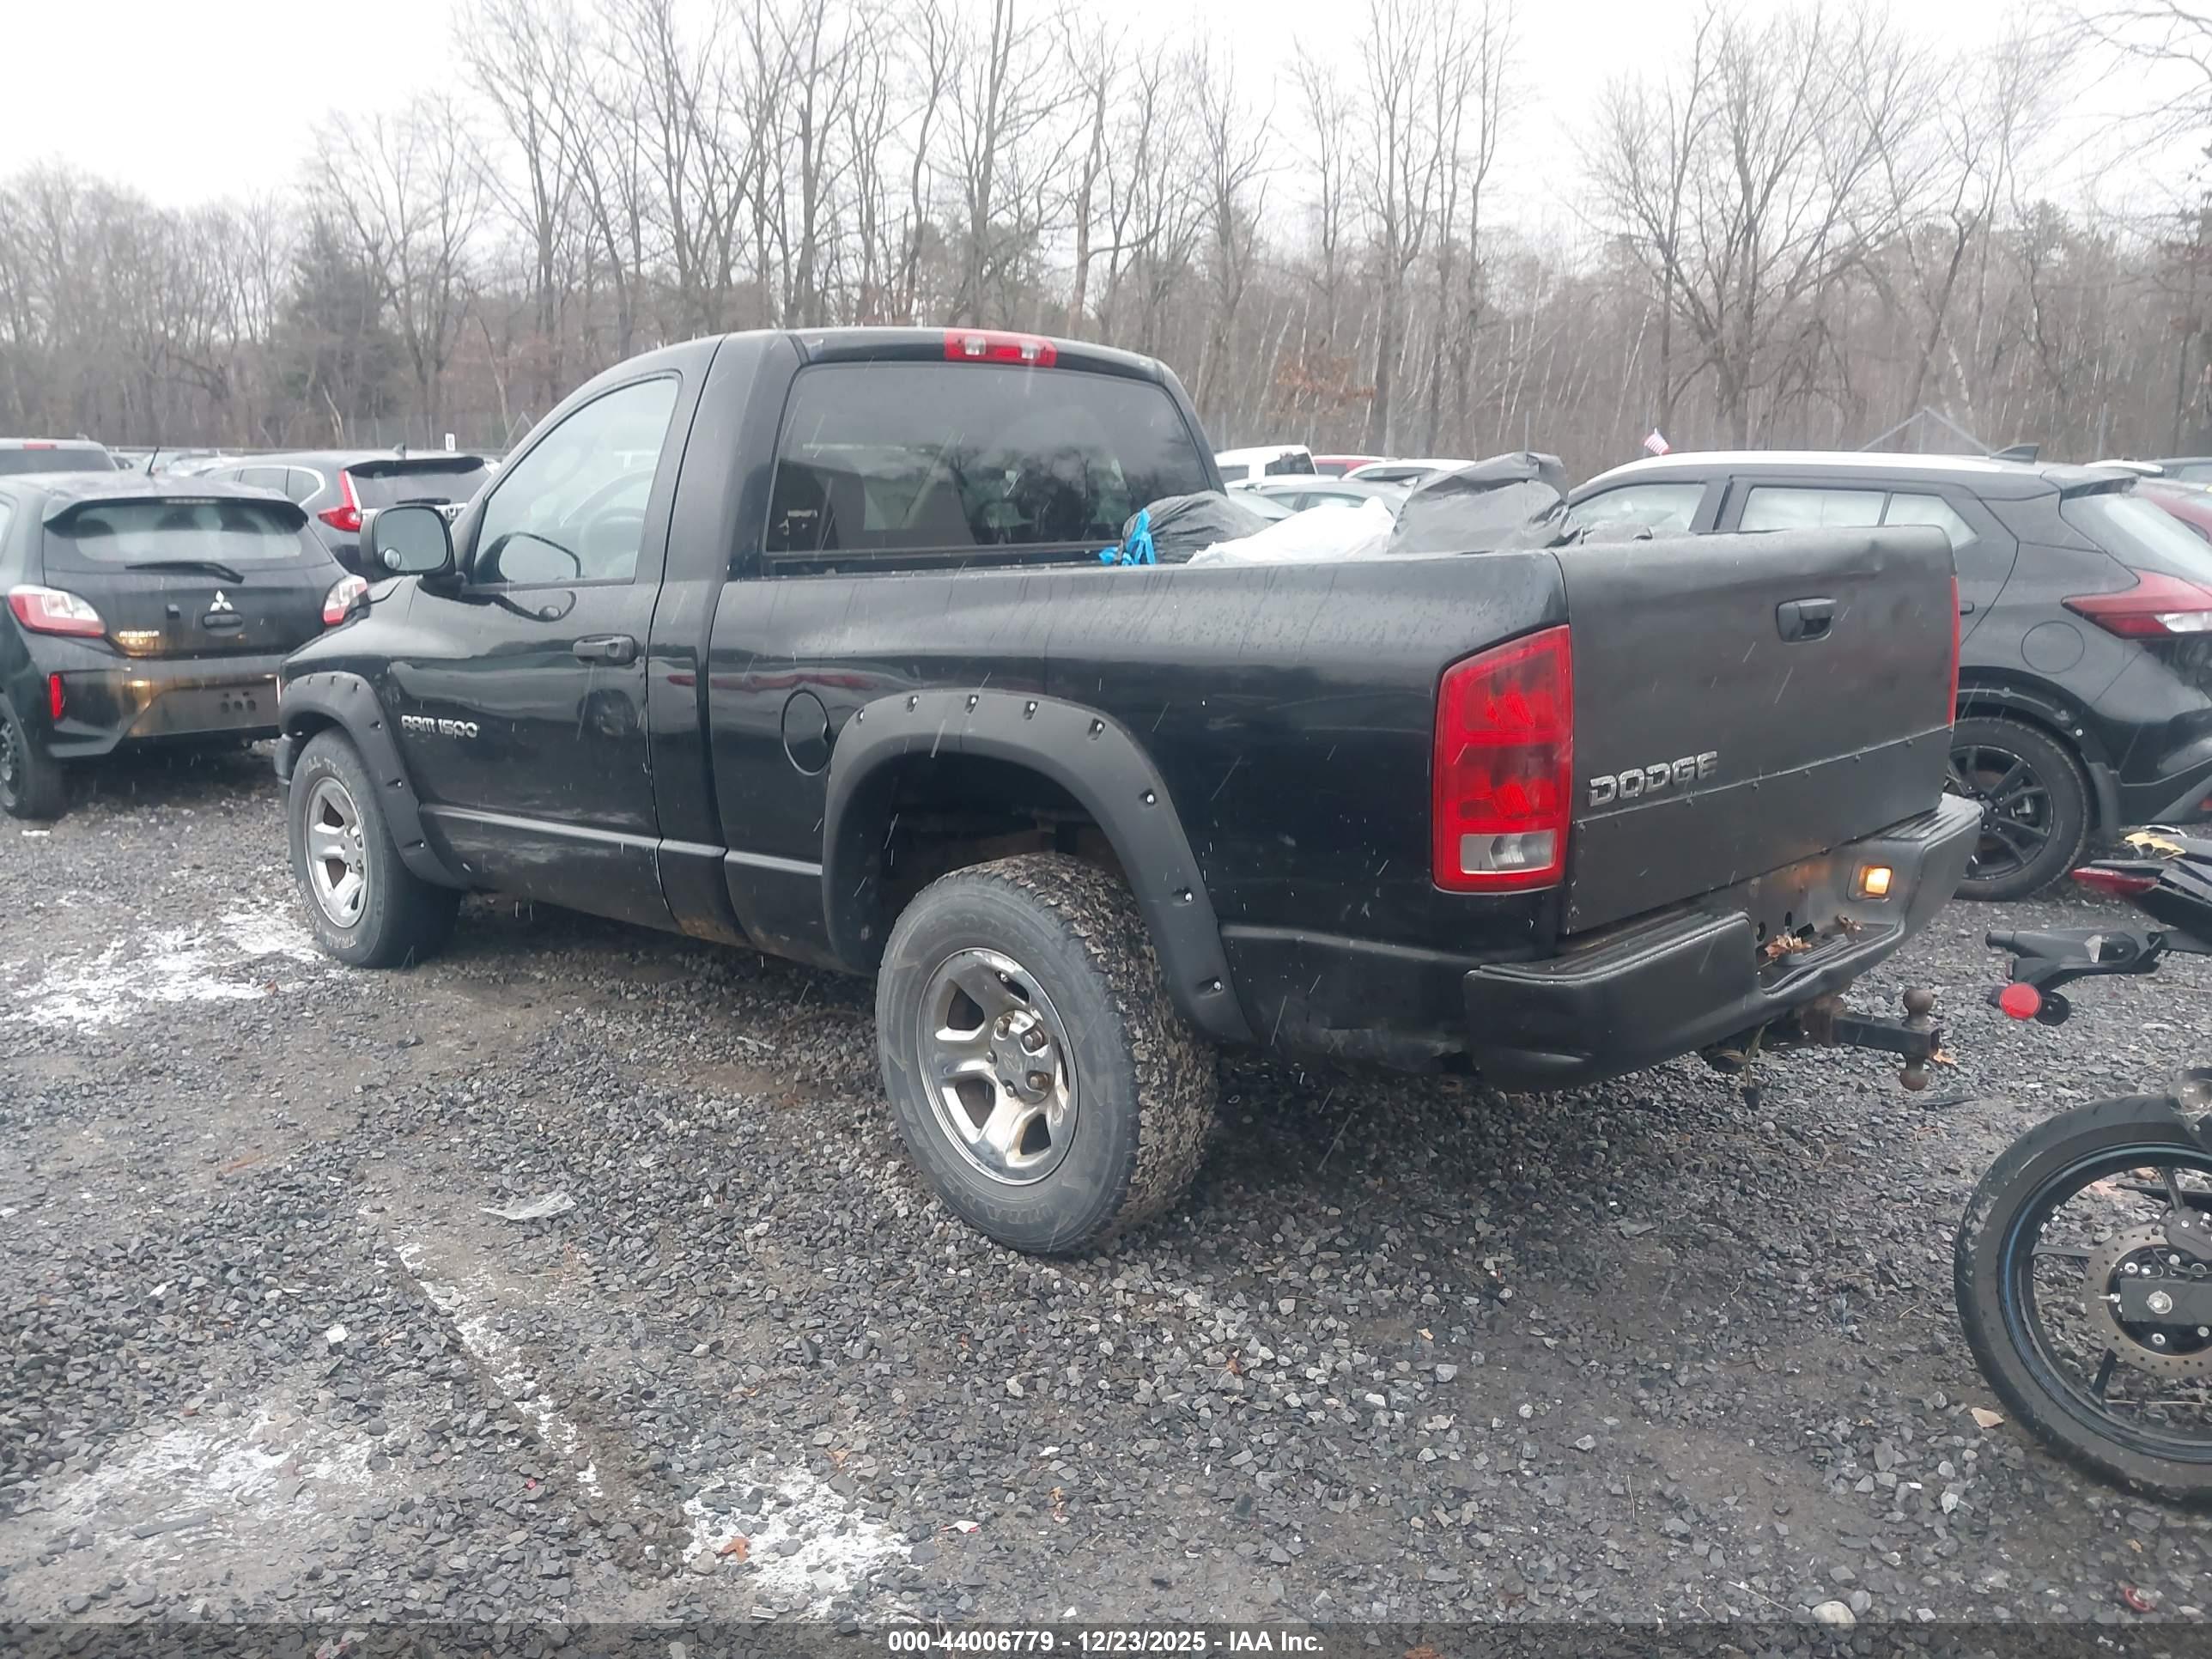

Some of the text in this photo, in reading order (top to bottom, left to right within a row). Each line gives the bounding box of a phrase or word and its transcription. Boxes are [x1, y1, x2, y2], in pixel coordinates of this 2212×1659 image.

[401, 714, 478, 739] RAM 1500
[1589, 750, 1718, 807] DODGE
